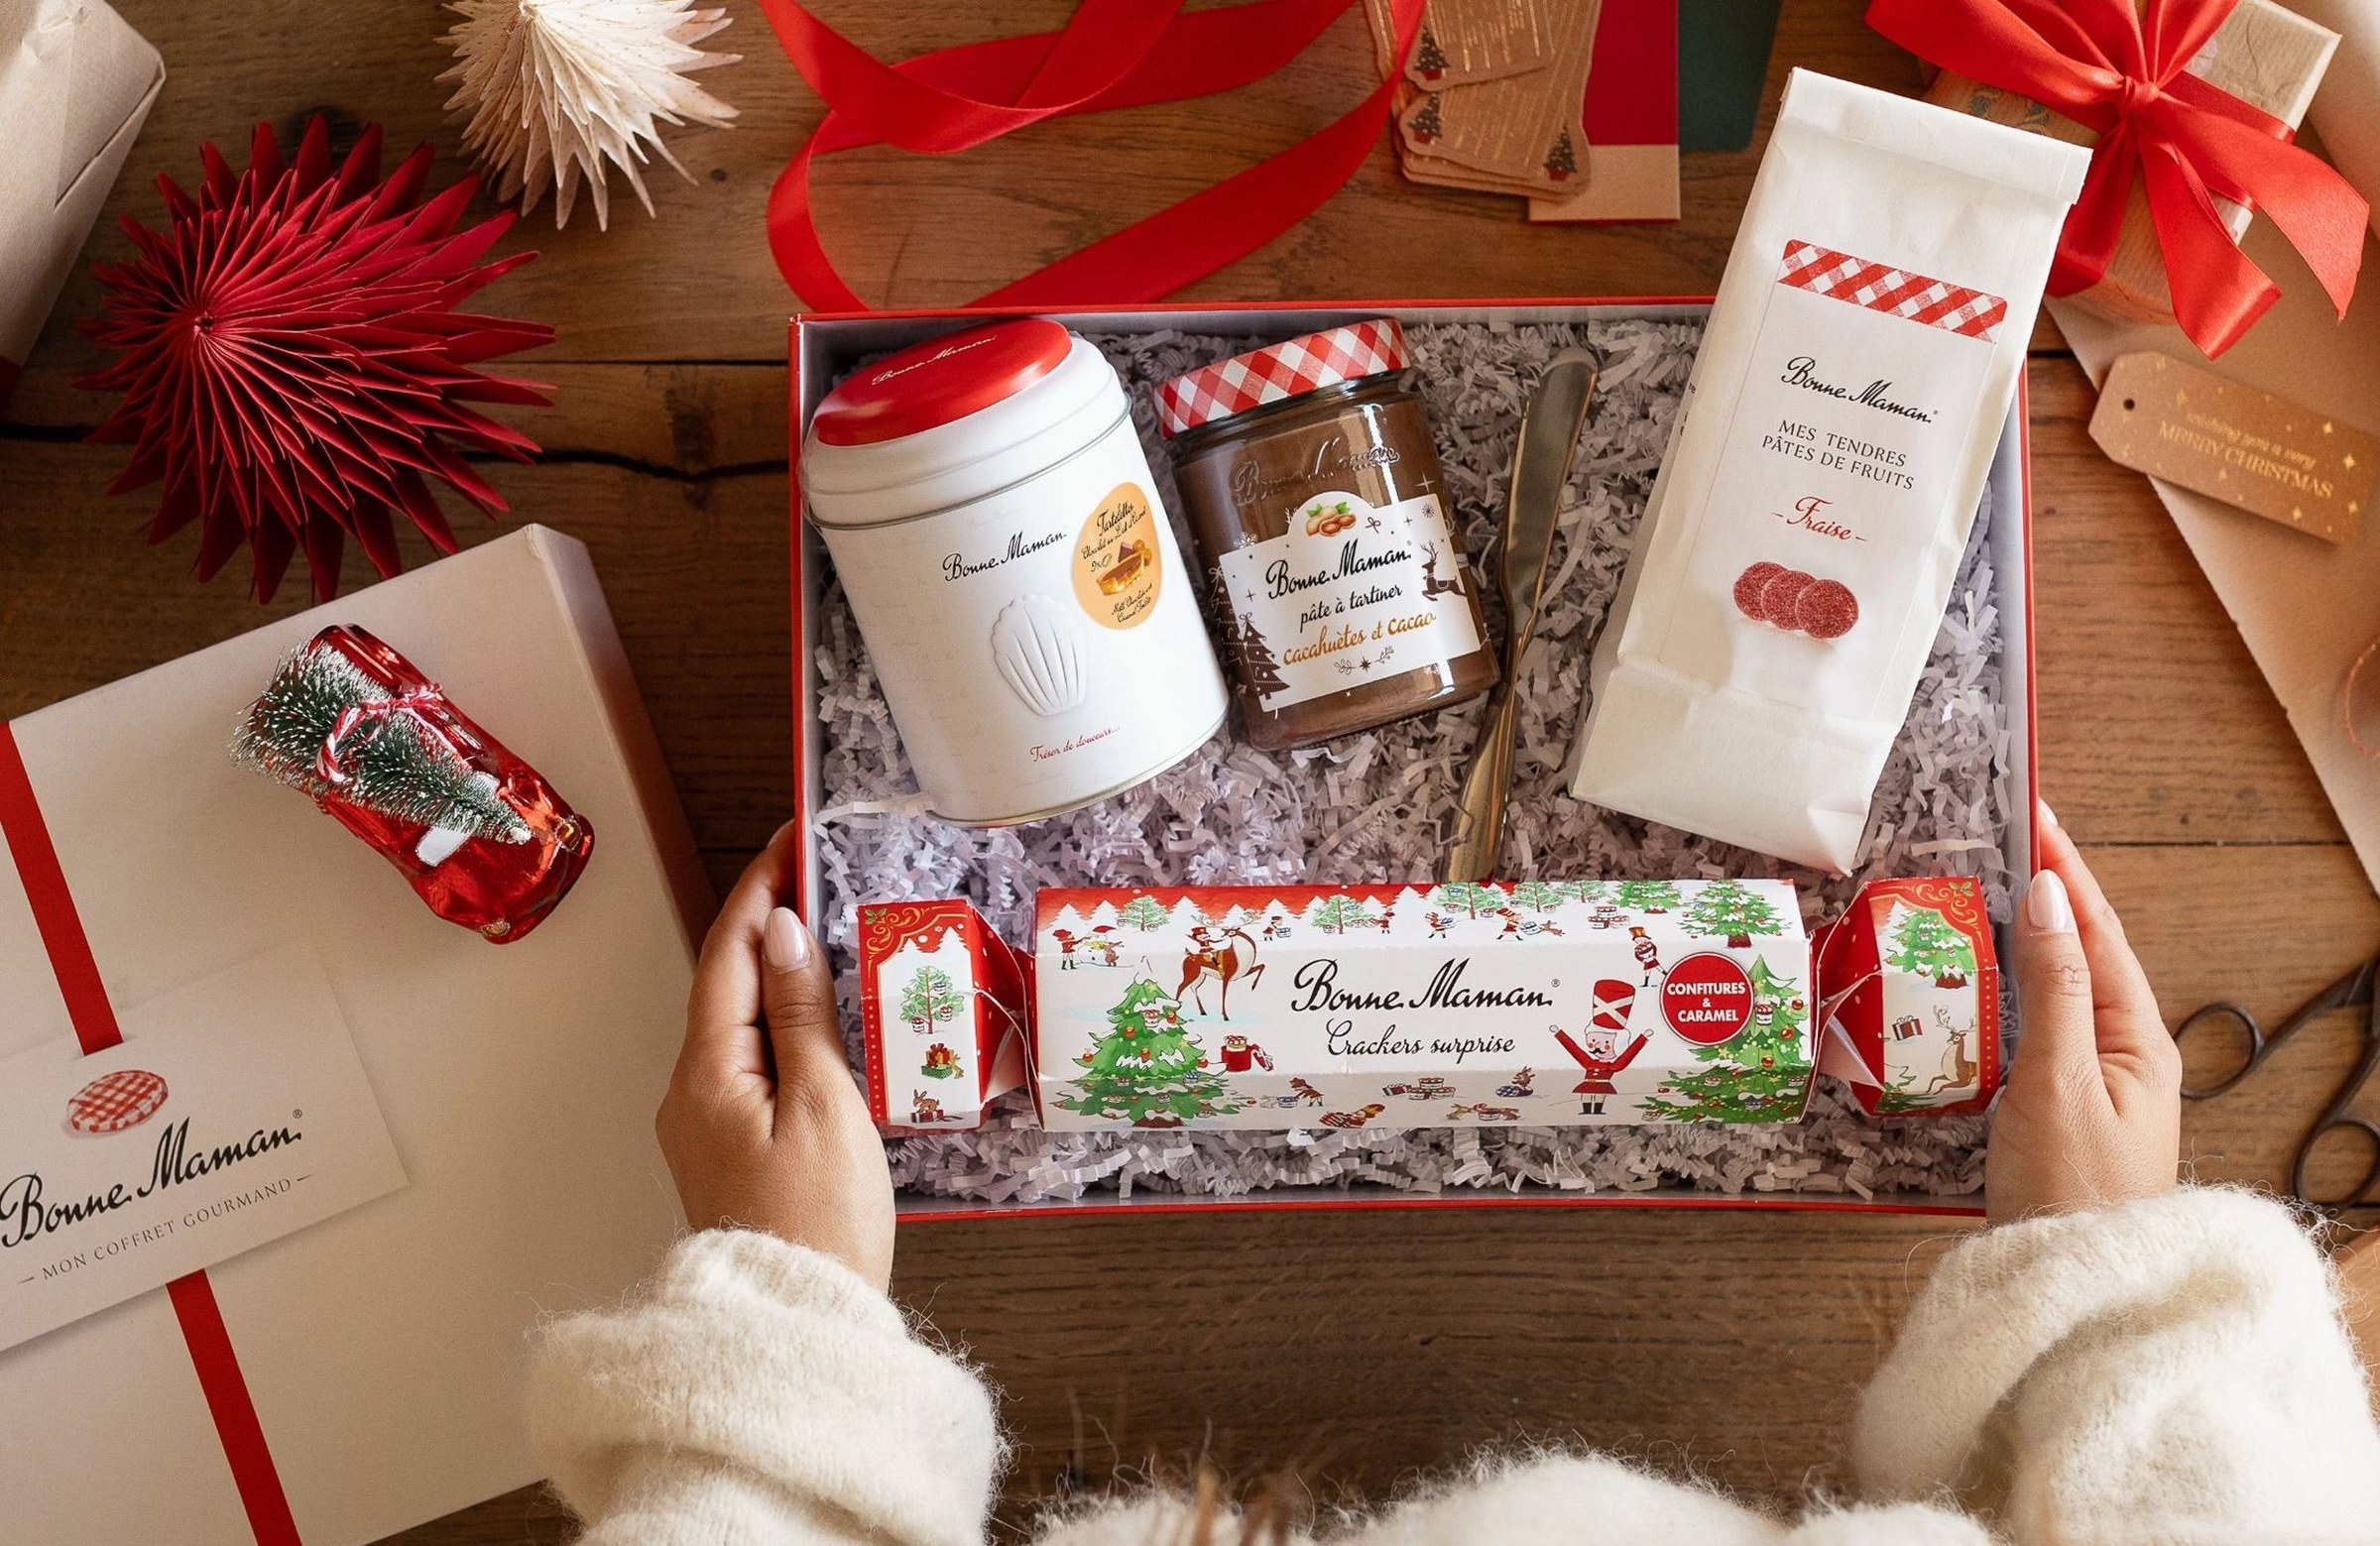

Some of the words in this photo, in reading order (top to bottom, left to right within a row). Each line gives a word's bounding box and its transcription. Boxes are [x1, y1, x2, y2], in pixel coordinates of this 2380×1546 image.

[1781, 356, 1846, 399] Bonne
[1762, 435, 1816, 461] PÂTES
[1820, 452, 1845, 470] DE
[1849, 461, 1915, 491] FRUITS
[1778, 419, 1817, 441] MES
[1827, 432, 1907, 467] TENDRES
[2224, 447, 2333, 499] CHRISTMAS
[942, 553, 999, 581] Bonne
[1265, 559, 1330, 599] Bonne
[1300, 604, 1330, 634] pâte
[1335, 597, 1345, 614] à
[1350, 584, 1402, 610] tartiner
[1283, 624, 1367, 665] cacahuètes
[1371, 621, 1382, 641] et
[1030, 744, 1060, 762] Trésor
[1063, 739, 1073, 753] de
[1290, 958, 1404, 1011] Bonne
[1667, 982, 1745, 995] CONFITURES
[1702, 997, 1712, 1008] &
[1677, 1010, 1738, 1022] CARAMEL
[1326, 1017, 1424, 1055] Crackers
[1430, 1035, 1515, 1064] surprise
[0, 1172, 132, 1248] Bonne
[42, 1252, 87, 1280] MON
[94, 1220, 176, 1260] COFFRET
[182, 1177, 292, 1228] GOURMAND
